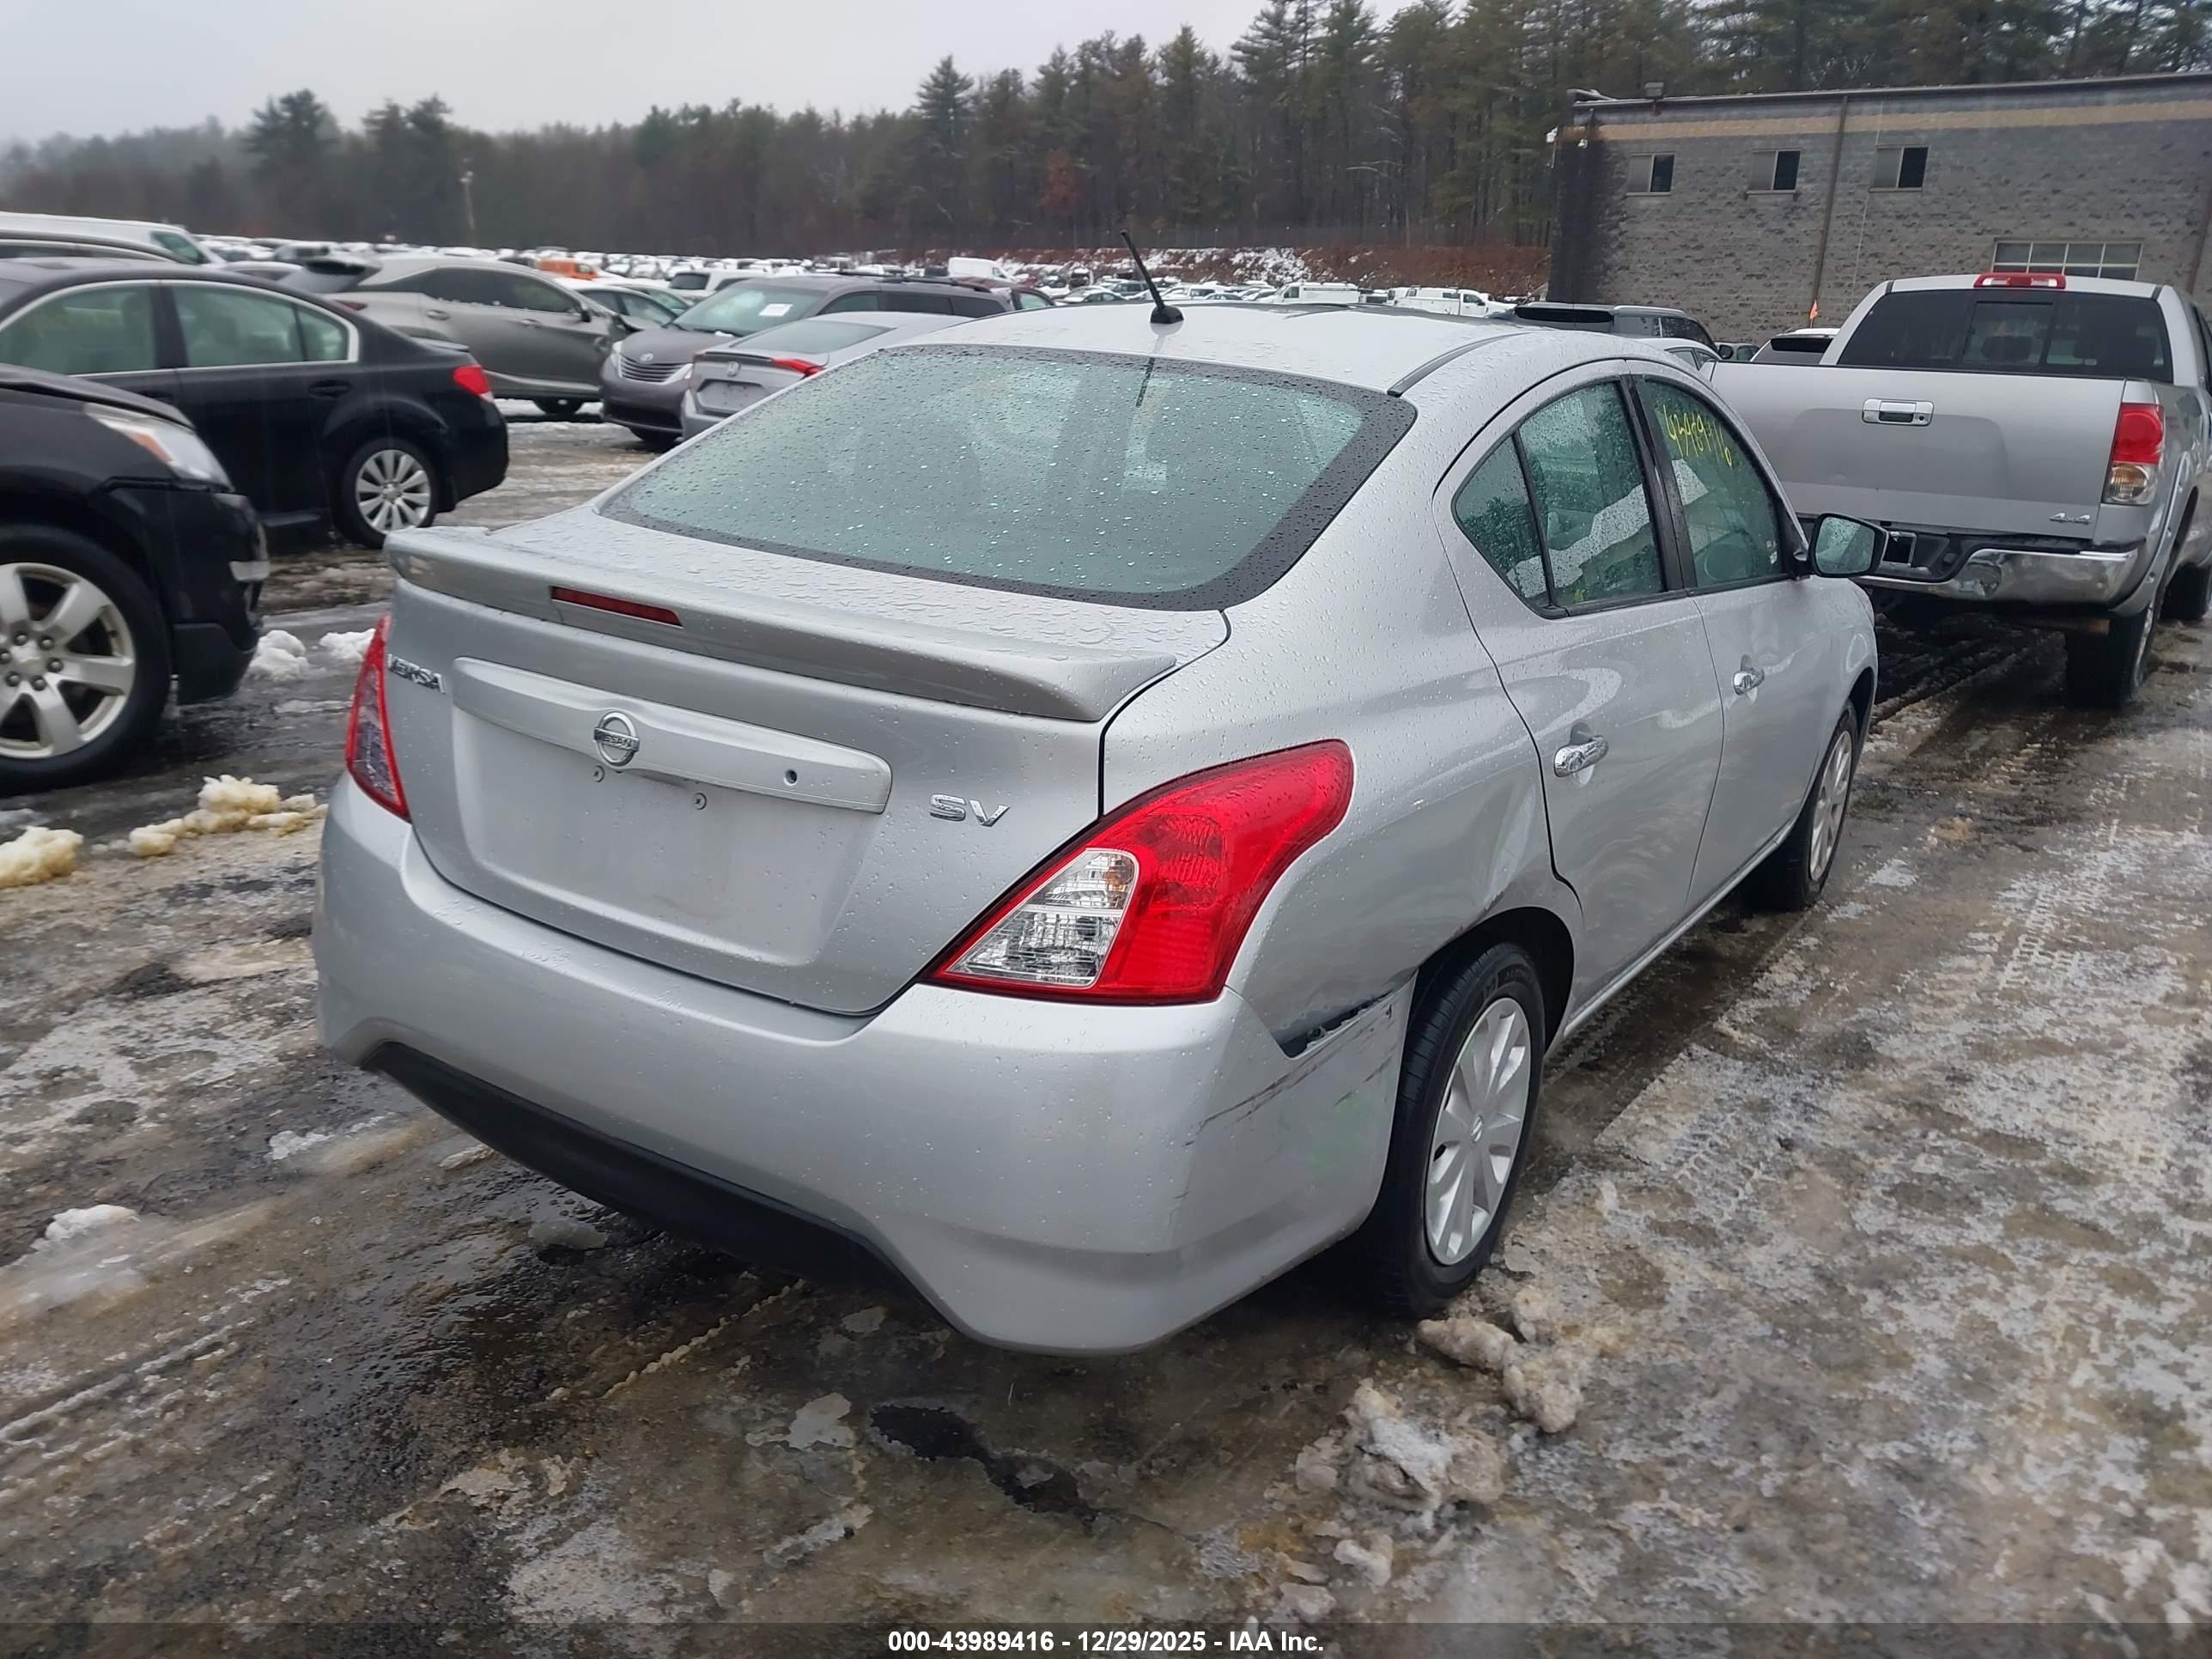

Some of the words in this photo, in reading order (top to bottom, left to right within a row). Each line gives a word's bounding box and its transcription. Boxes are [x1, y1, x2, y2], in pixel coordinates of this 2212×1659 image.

[386, 653, 446, 694] VERSA
[596, 730, 632, 750] SSAN
[927, 792, 1010, 828] SV
